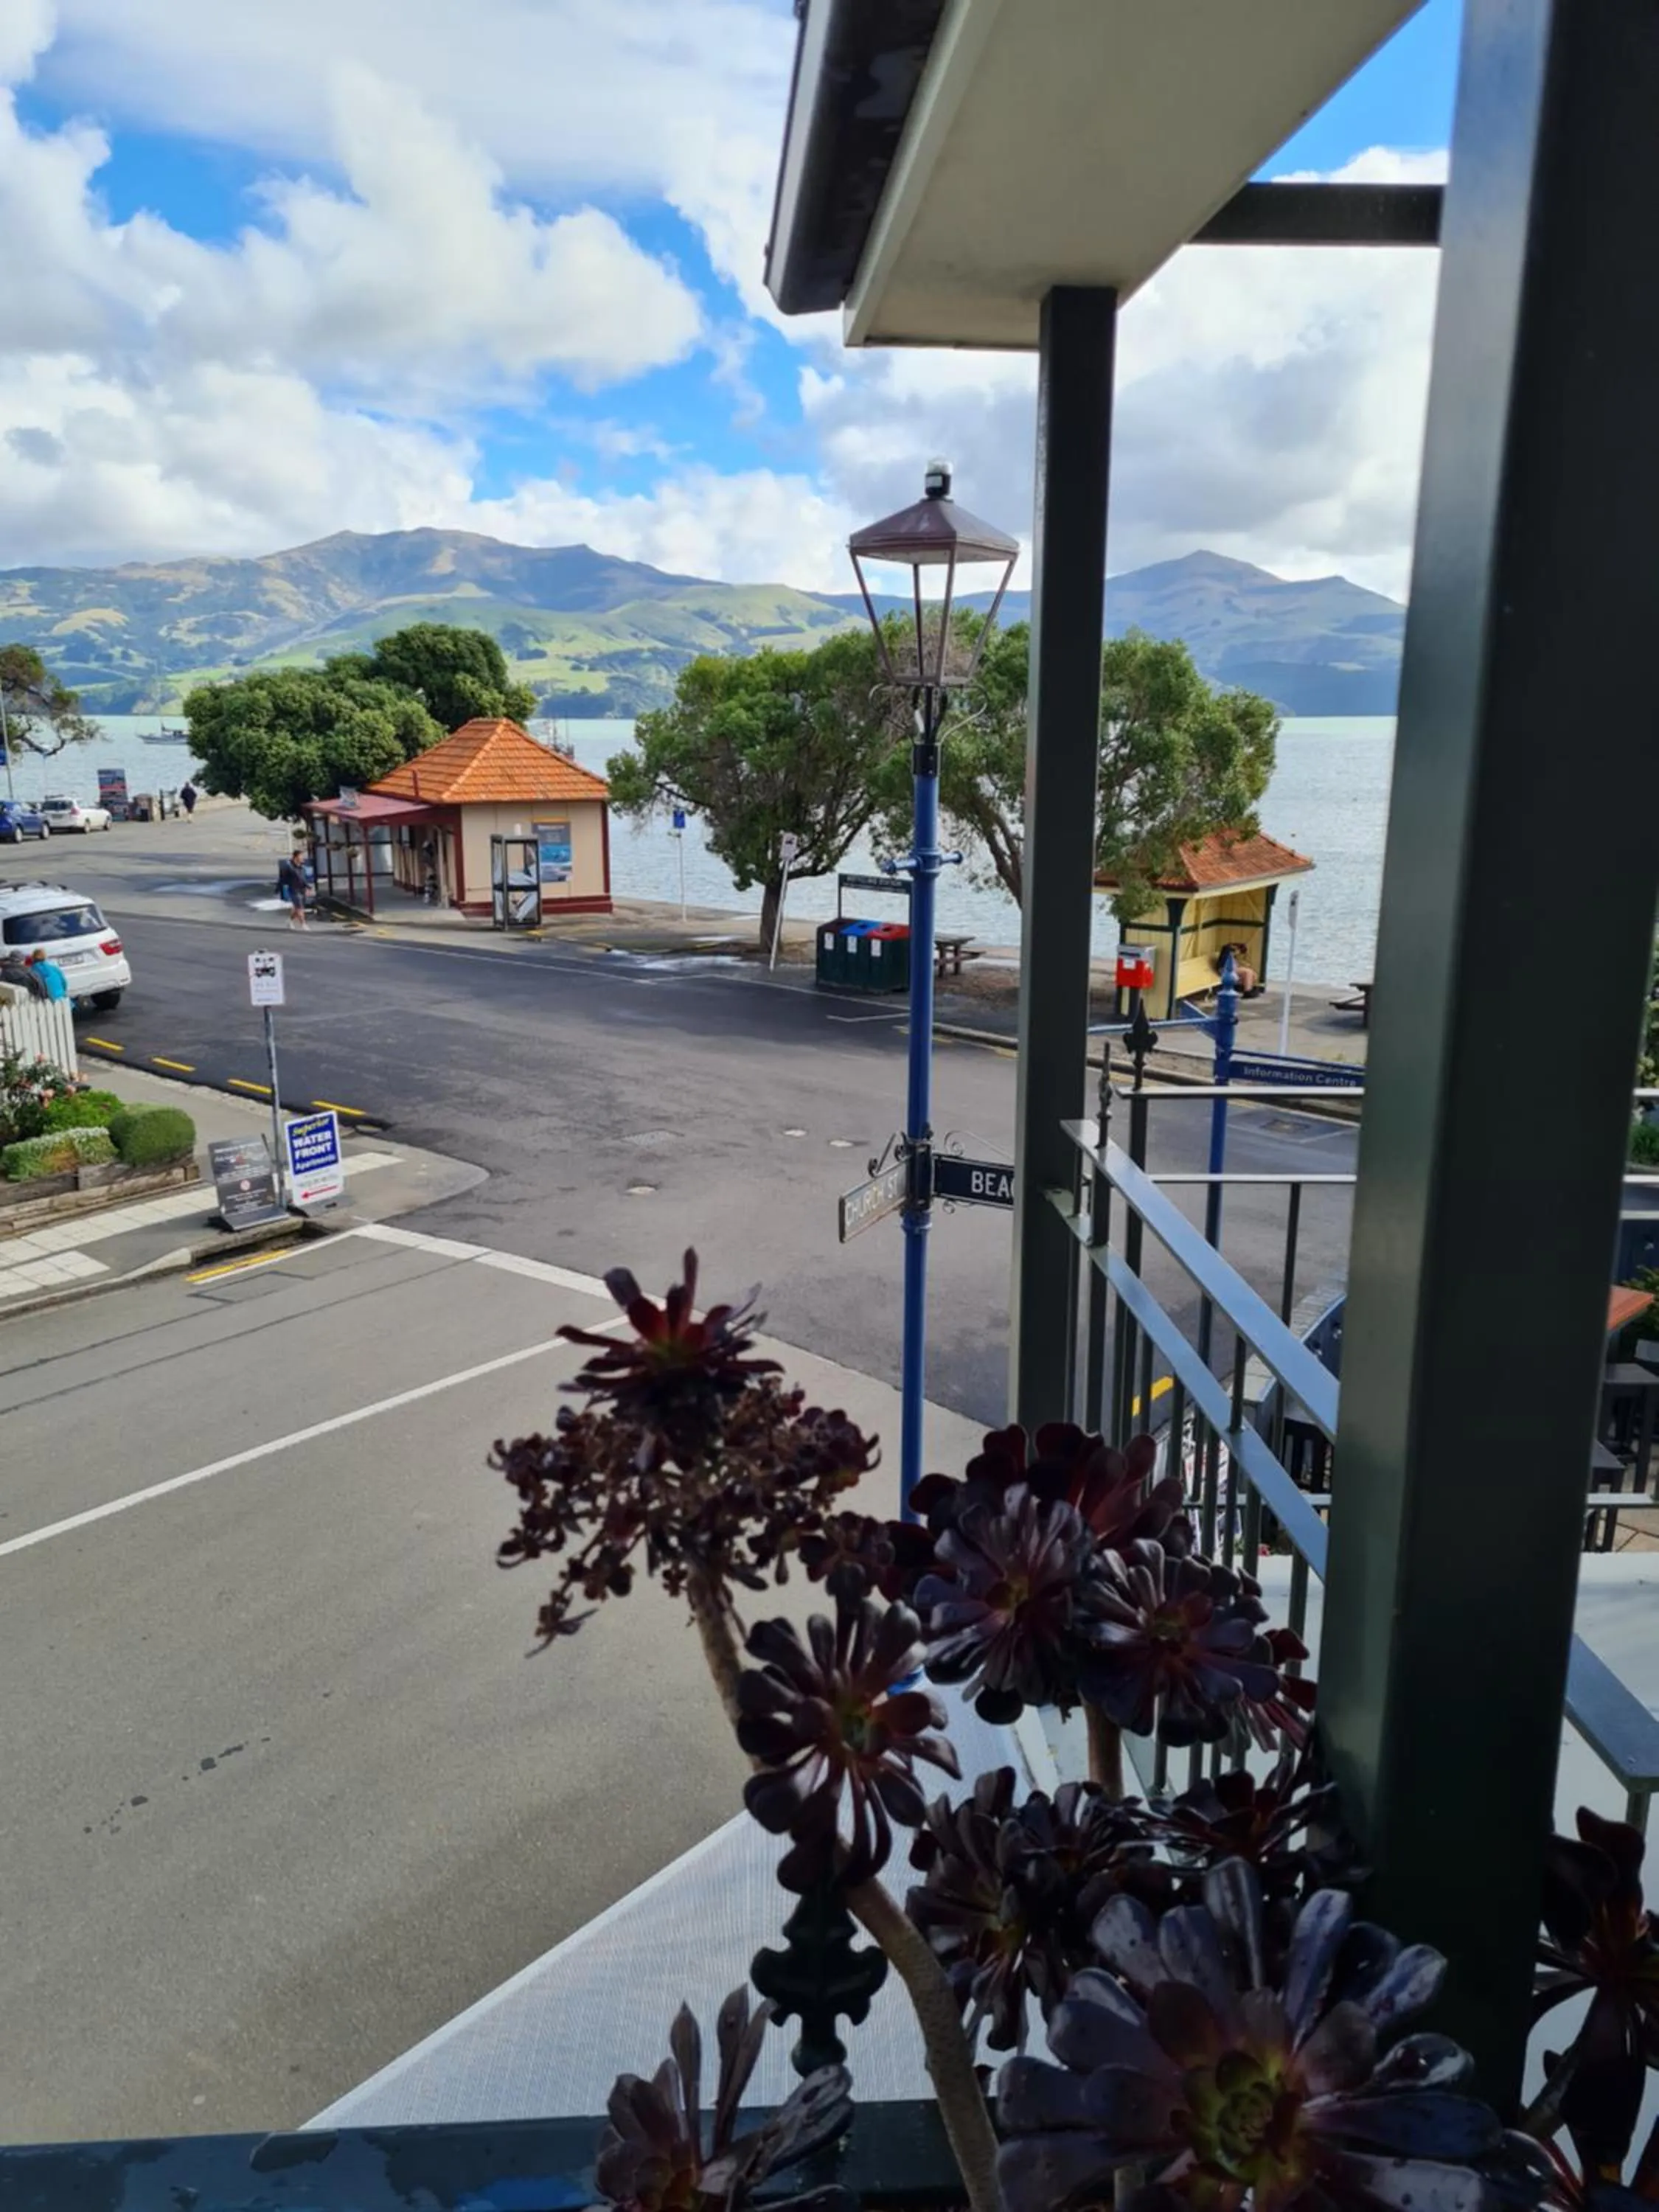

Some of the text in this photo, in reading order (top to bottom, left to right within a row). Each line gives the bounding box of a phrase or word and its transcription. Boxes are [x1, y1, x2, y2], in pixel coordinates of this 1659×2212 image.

[1243, 1066, 1357, 1087] Information Centre
[293, 1130, 332, 1148] WATER
[295, 1141, 331, 1161] FRONT
